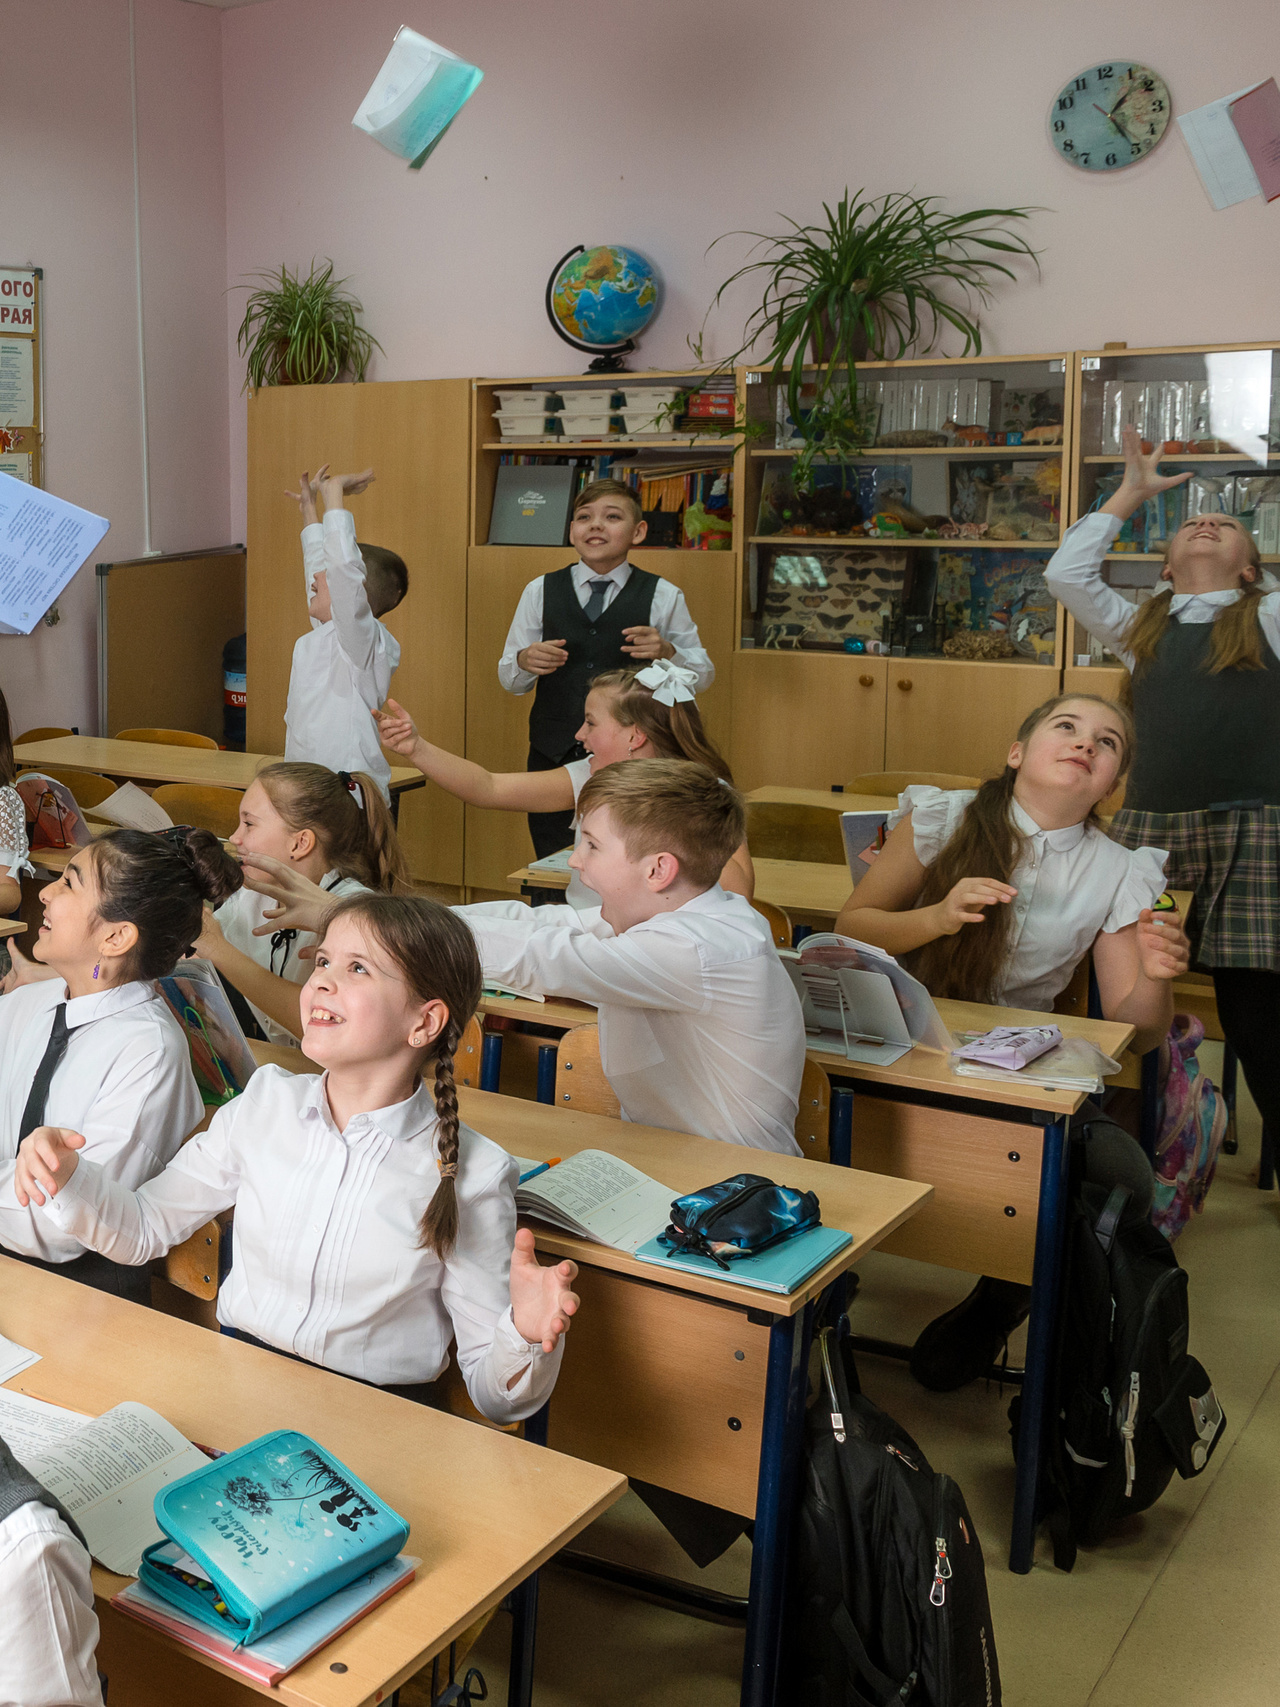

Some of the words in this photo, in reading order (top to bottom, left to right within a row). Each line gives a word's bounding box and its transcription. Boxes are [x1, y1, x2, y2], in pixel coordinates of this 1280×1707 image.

[1097, 66, 1113, 80] 12
[1127, 68, 1133, 80] 1
[1074, 78, 1087, 91] 11
[1144, 80, 1154, 91] 2
[1057, 96, 1073, 110] 10
[1152, 100, 1163, 113] 3
[1054, 120, 1065, 133] 9
[1146, 123, 1156, 135] 4
[1063, 139, 1074, 152] 8
[1131, 143, 1141, 155] 5
[1080, 152, 1090, 165] 7
[1105, 153, 1116, 166] 6
